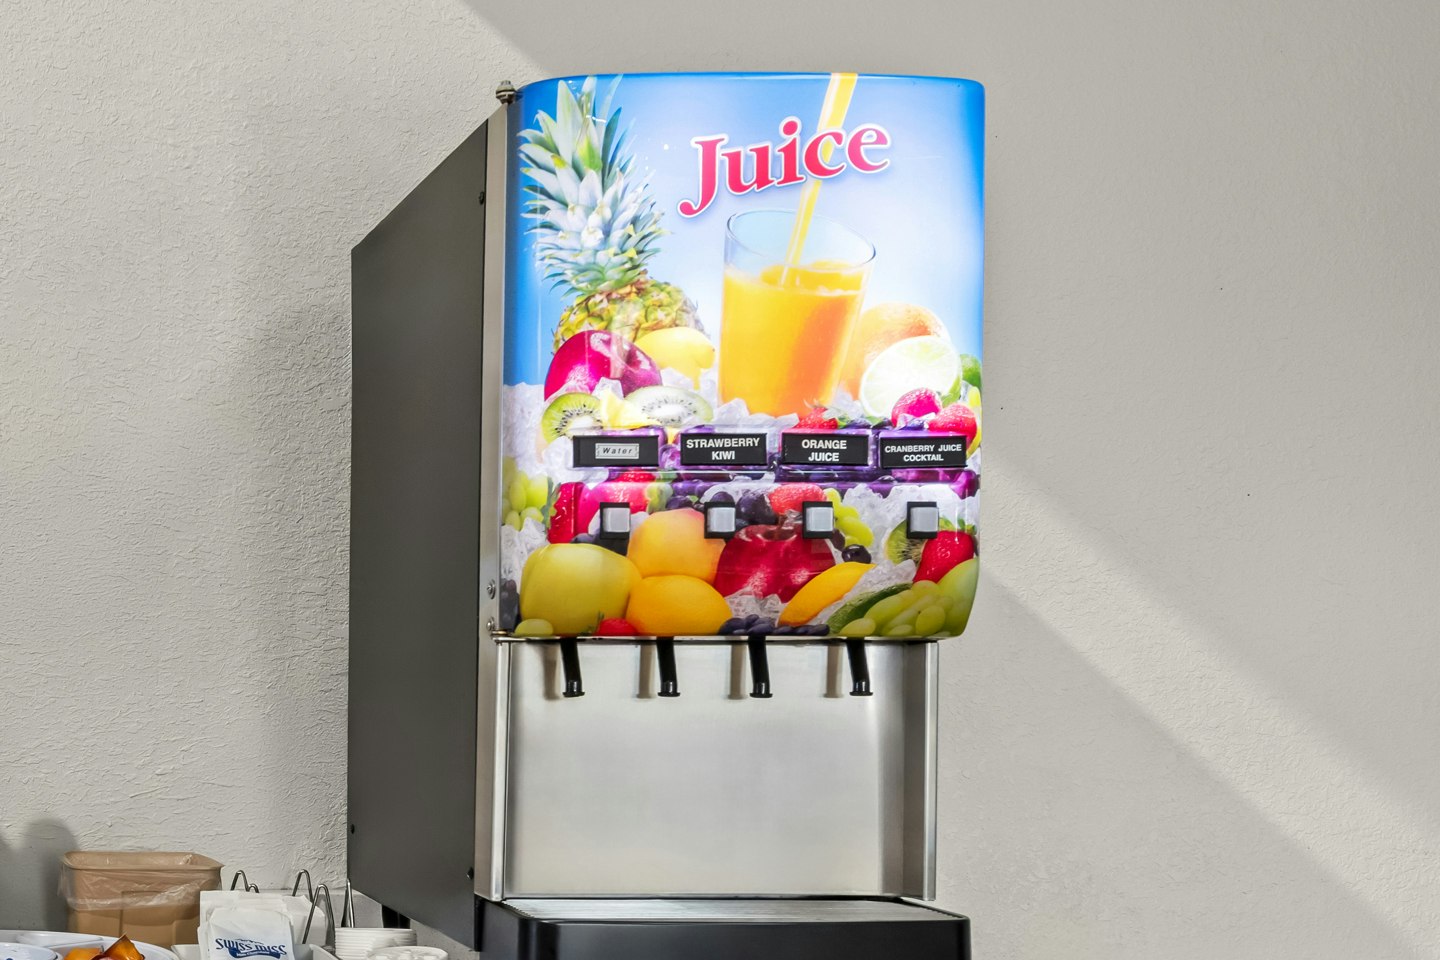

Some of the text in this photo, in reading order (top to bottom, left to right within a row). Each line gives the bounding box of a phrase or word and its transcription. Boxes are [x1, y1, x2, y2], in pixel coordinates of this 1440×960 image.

[677, 116, 891, 217] Juice
[686, 437, 760, 449] STRAWBERRY
[801, 439, 847, 449] ORANGE
[884, 443, 962, 453] CRANBERRY JUICE
[602, 447, 633, 455] Water
[711, 450, 736, 461] KIWI
[808, 452, 840, 462] JUICE
[903, 453, 944, 462] COCKTAIL
